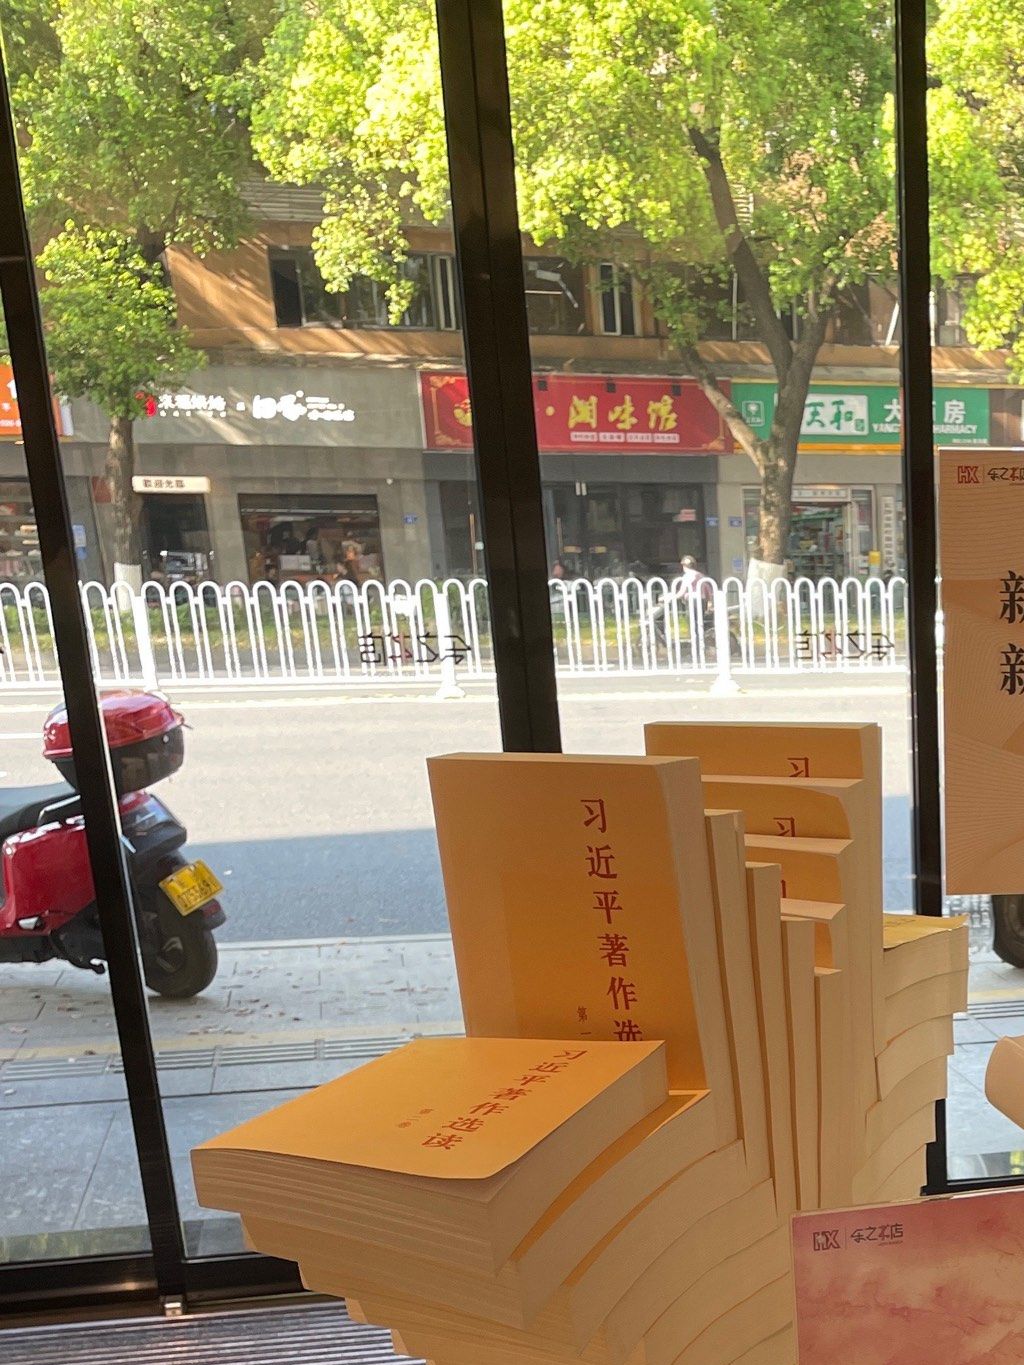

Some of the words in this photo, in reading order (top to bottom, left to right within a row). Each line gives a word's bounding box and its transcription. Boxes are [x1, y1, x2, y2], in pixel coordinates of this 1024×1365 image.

[884, 400, 966, 424] 大房
[957, 465, 980, 484] HX
[580, 799, 644, 1041] 习近平著作选
[421, 1050, 588, 1150] 习近平著作选读
[813, 1229, 840, 1251] HX
